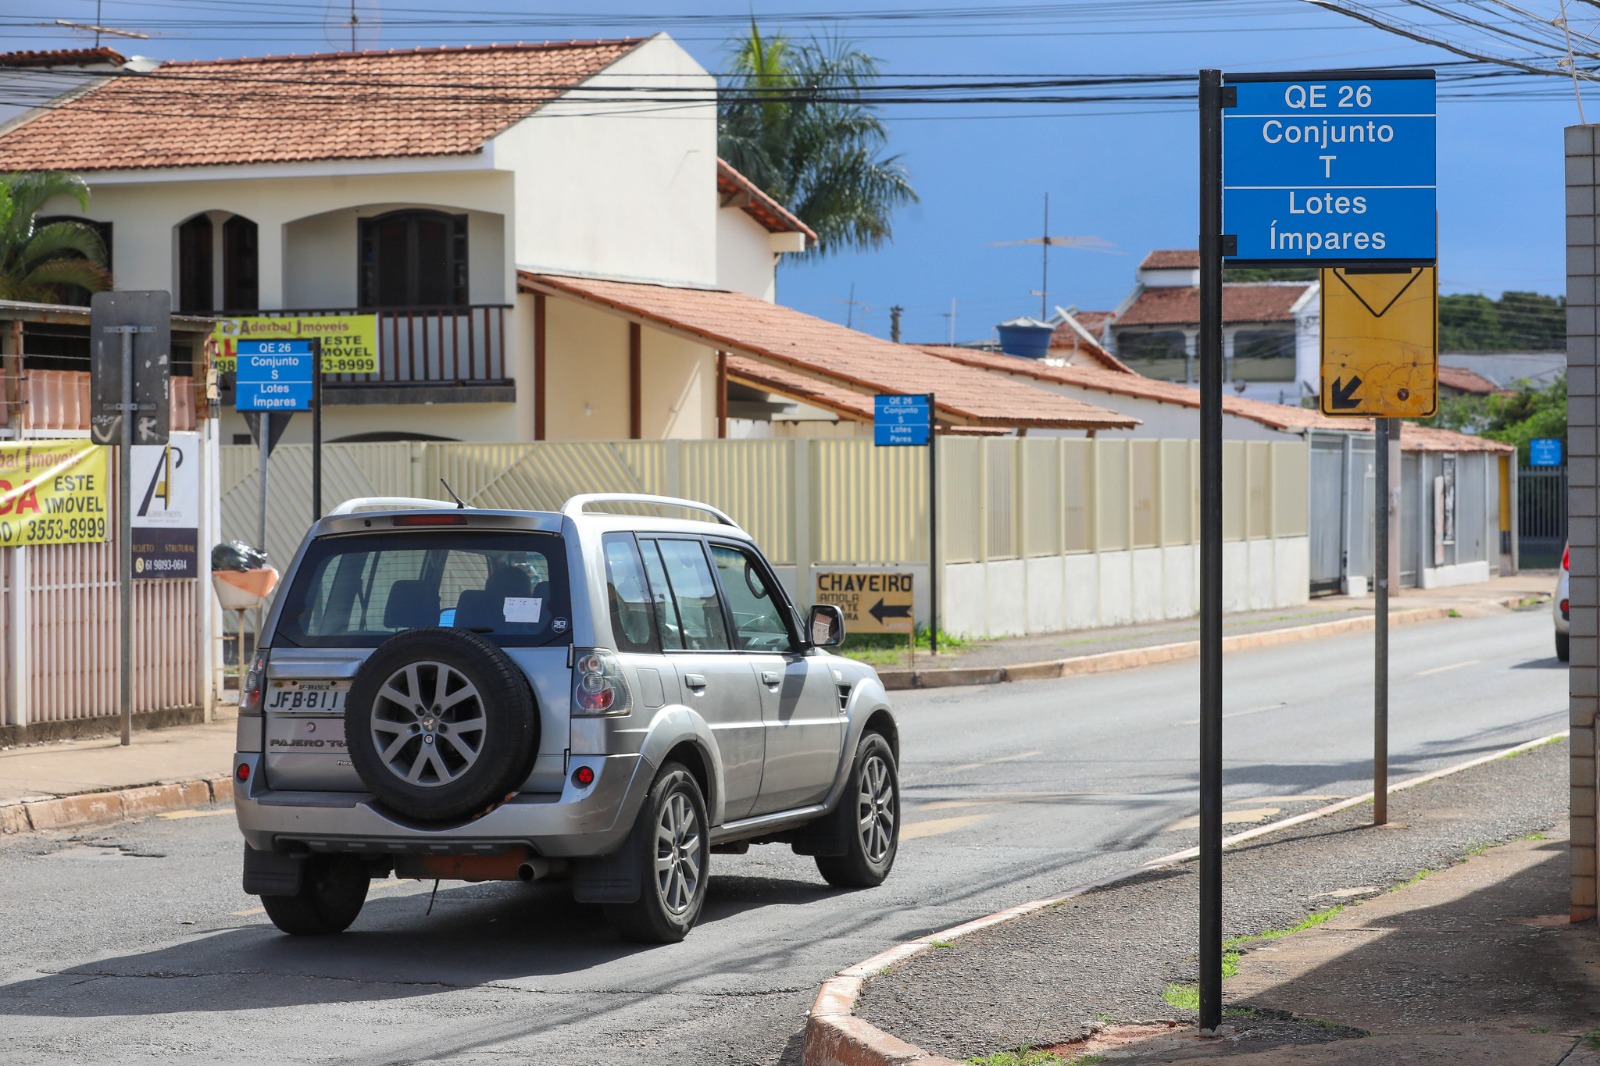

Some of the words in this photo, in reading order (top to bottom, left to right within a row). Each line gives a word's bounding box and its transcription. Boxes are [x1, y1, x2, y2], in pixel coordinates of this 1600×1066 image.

[1284, 84, 1327, 109] QE
[1338, 85, 1372, 108] 26
[1262, 119, 1394, 149] Conjunto
[1318, 155, 1337, 178] T
[1289, 191, 1367, 214] Lotes
[1270, 219, 1386, 256] Ímpares
[239, 319, 292, 335] Aderbal
[296, 319, 349, 334] Imóveis
[324, 335, 362, 345] ESTE
[259, 343, 275, 353] QE
[278, 343, 291, 353] 26
[251, 356, 299, 368] Conjunto
[271, 370, 279, 380] S
[260, 383, 289, 394] Lotes
[253, 394, 296, 409] Ímpares
[889, 397, 901, 405] QE
[883, 406, 919, 415] Conjunto
[890, 435, 912, 443] Pares
[54, 475, 94, 492] ESTE
[45, 493, 104, 514] IMÓVEL
[27, 517, 105, 541] 3553-8999
[818, 574, 912, 592] CHAVEIRO
[270, 739, 325, 747] PAJERO
